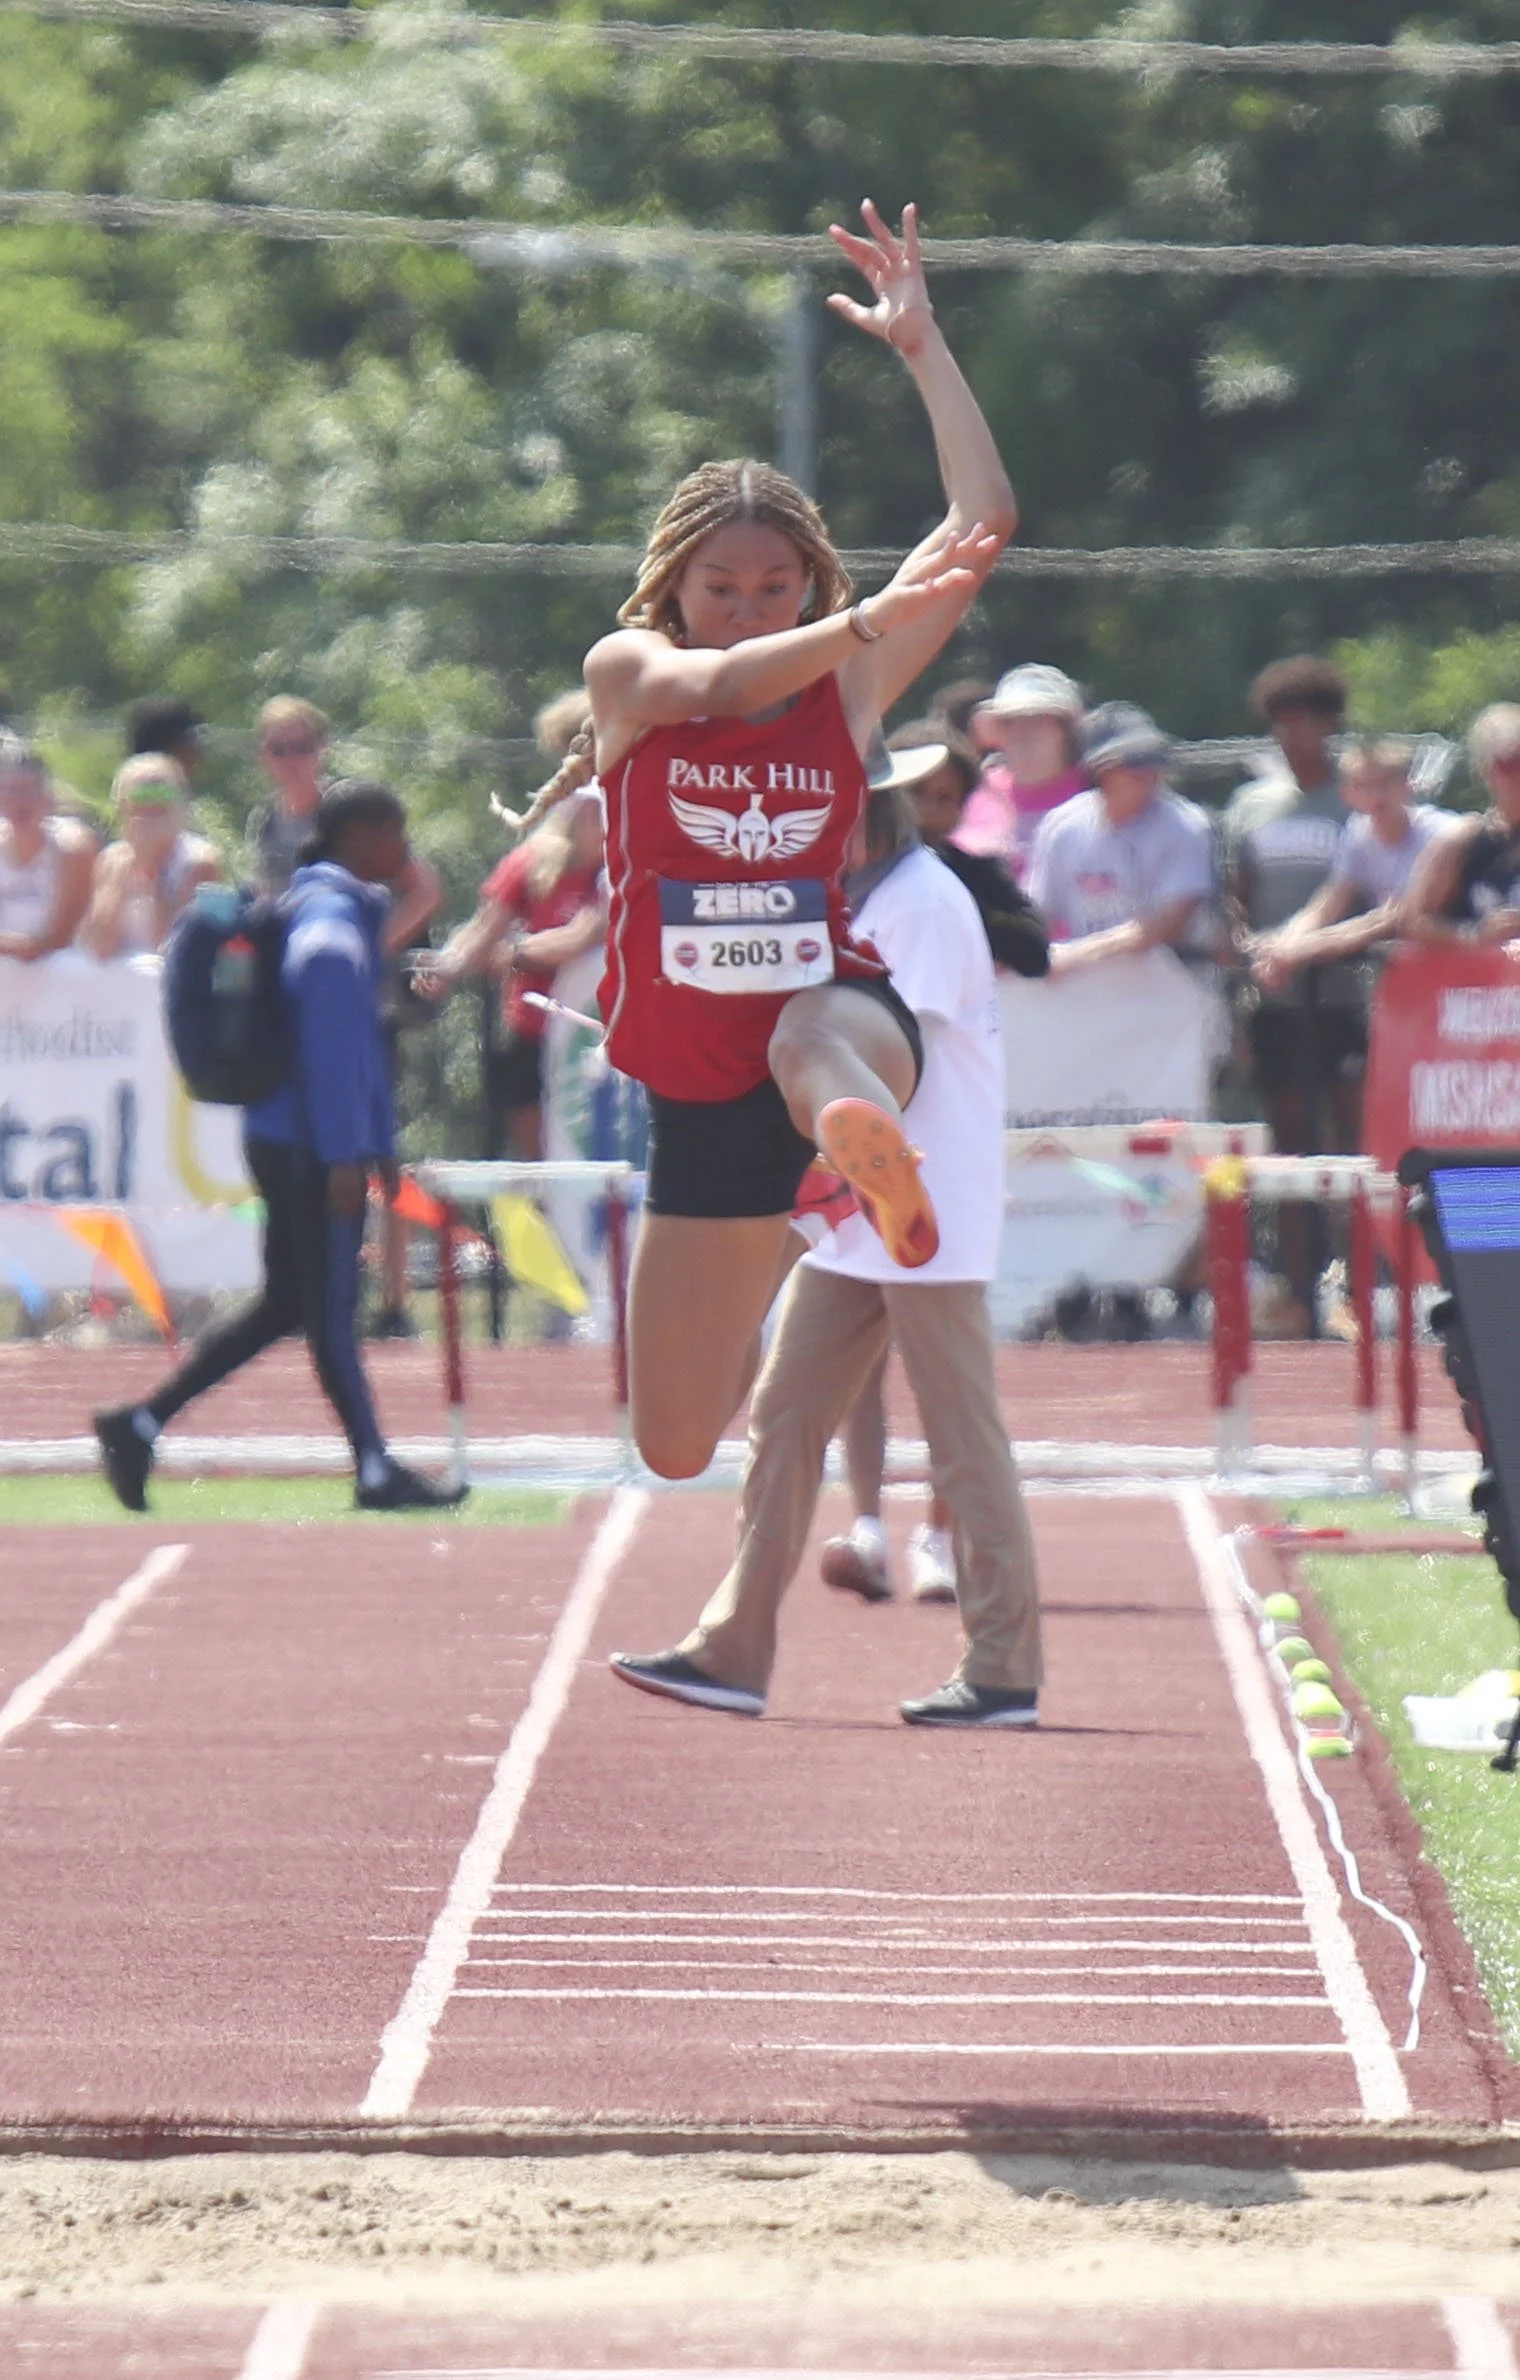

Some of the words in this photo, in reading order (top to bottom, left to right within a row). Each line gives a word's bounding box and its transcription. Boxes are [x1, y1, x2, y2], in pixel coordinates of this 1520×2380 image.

[667, 757, 757, 790] PARK
[767, 762, 836, 796] HILL
[692, 884, 797, 918] ZERO
[710, 938, 784, 968] 2603
